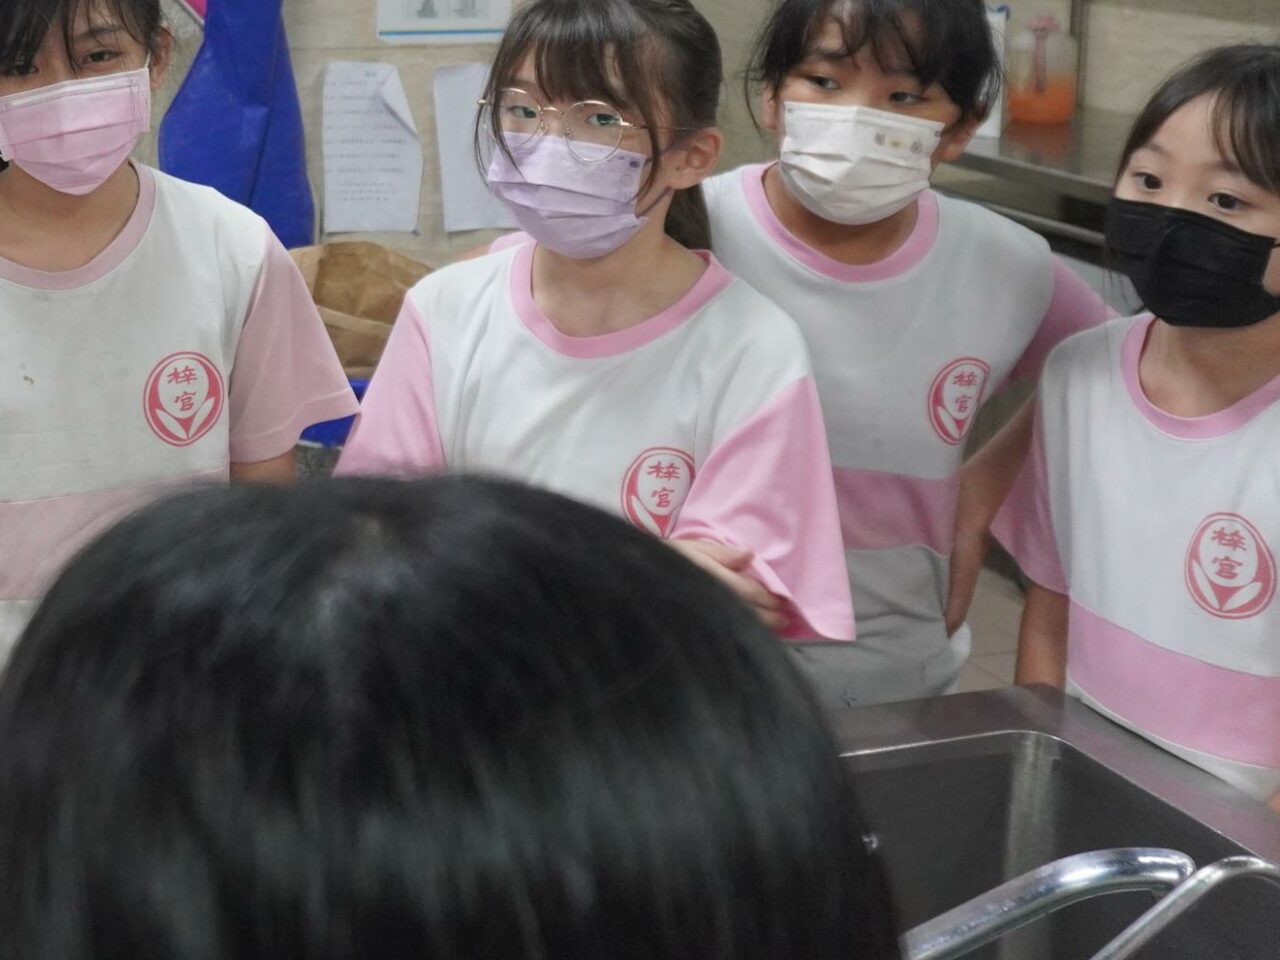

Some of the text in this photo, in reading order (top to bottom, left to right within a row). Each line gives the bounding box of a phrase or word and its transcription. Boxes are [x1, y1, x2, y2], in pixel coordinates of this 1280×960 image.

[166, 364, 198, 412] 梓官
[952, 371, 979, 413] 梓官
[646, 460, 681, 508] 梓官
[1210, 526, 1248, 580] 梓官
